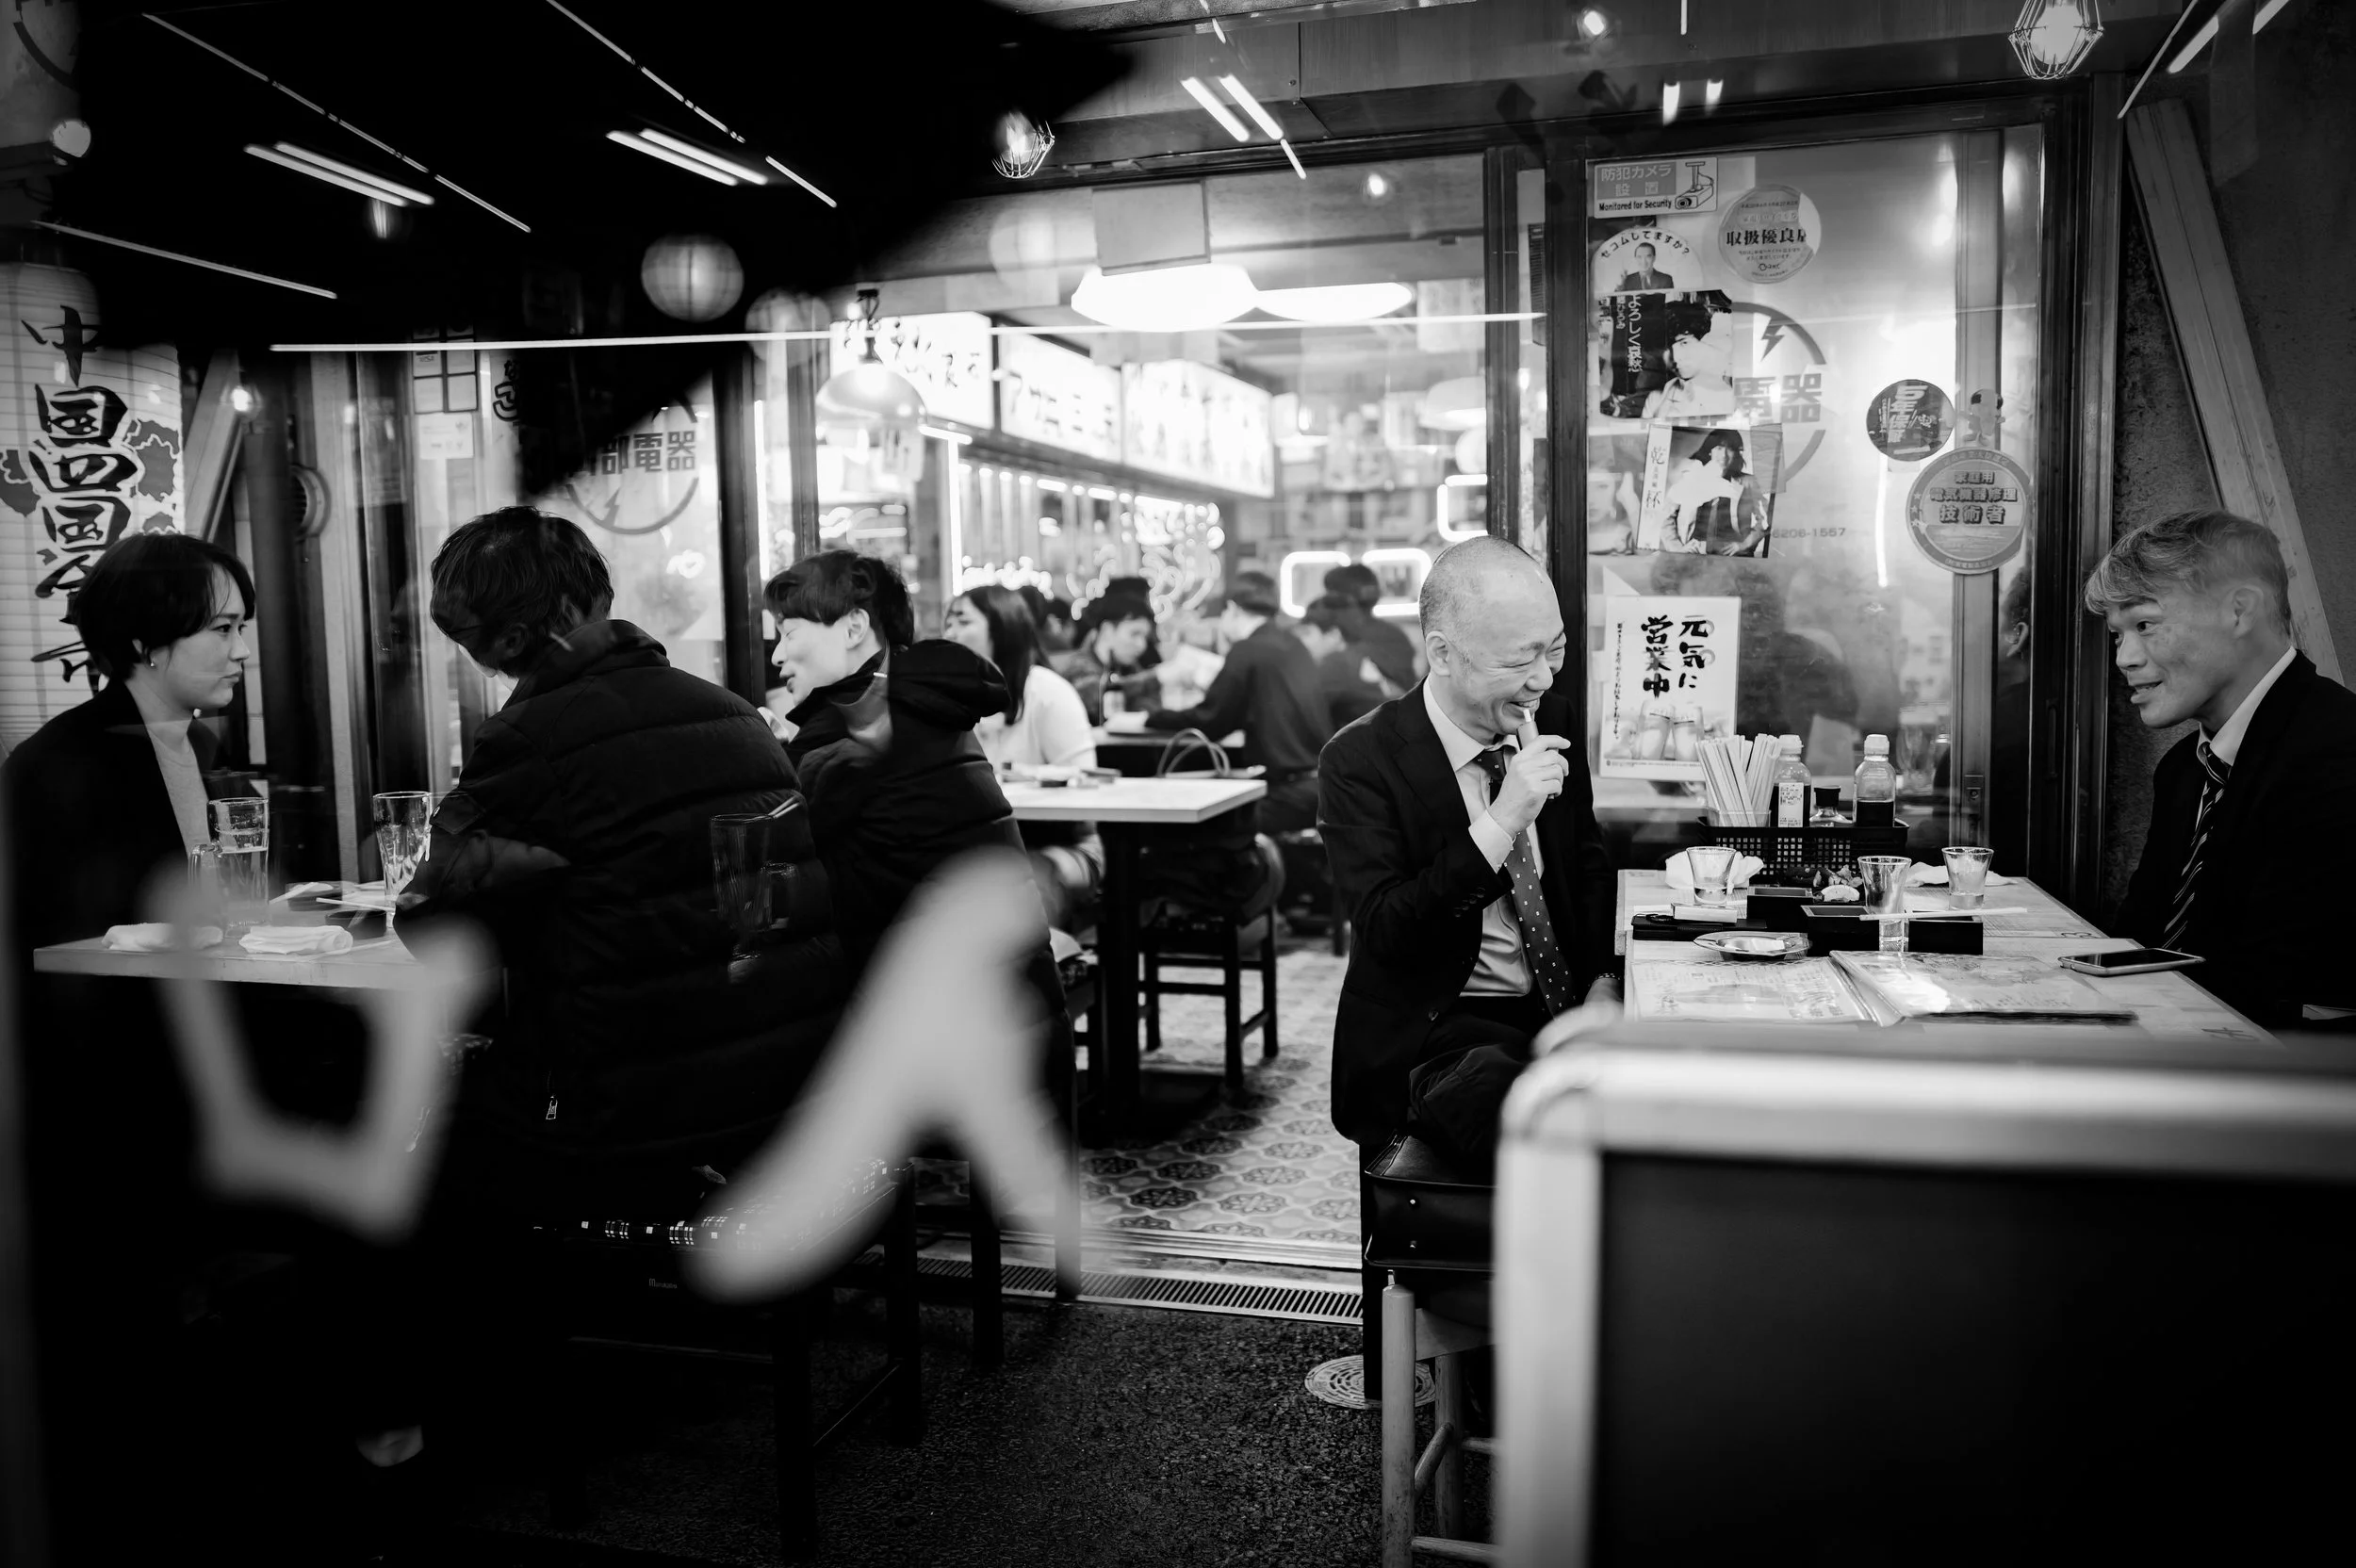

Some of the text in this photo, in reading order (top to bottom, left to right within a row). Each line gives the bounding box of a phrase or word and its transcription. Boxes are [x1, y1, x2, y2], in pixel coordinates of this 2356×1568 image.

[1601, 164, 1672, 182] 防犯カメラ
[1599, 198, 1672, 211] Monitored for Security
[588, 431, 695, 476] 部電器
[1939, 504, 2005, 524] 技術者
[1641, 614, 1674, 699] 営業中
[1678, 615, 1710, 689] 元気に
